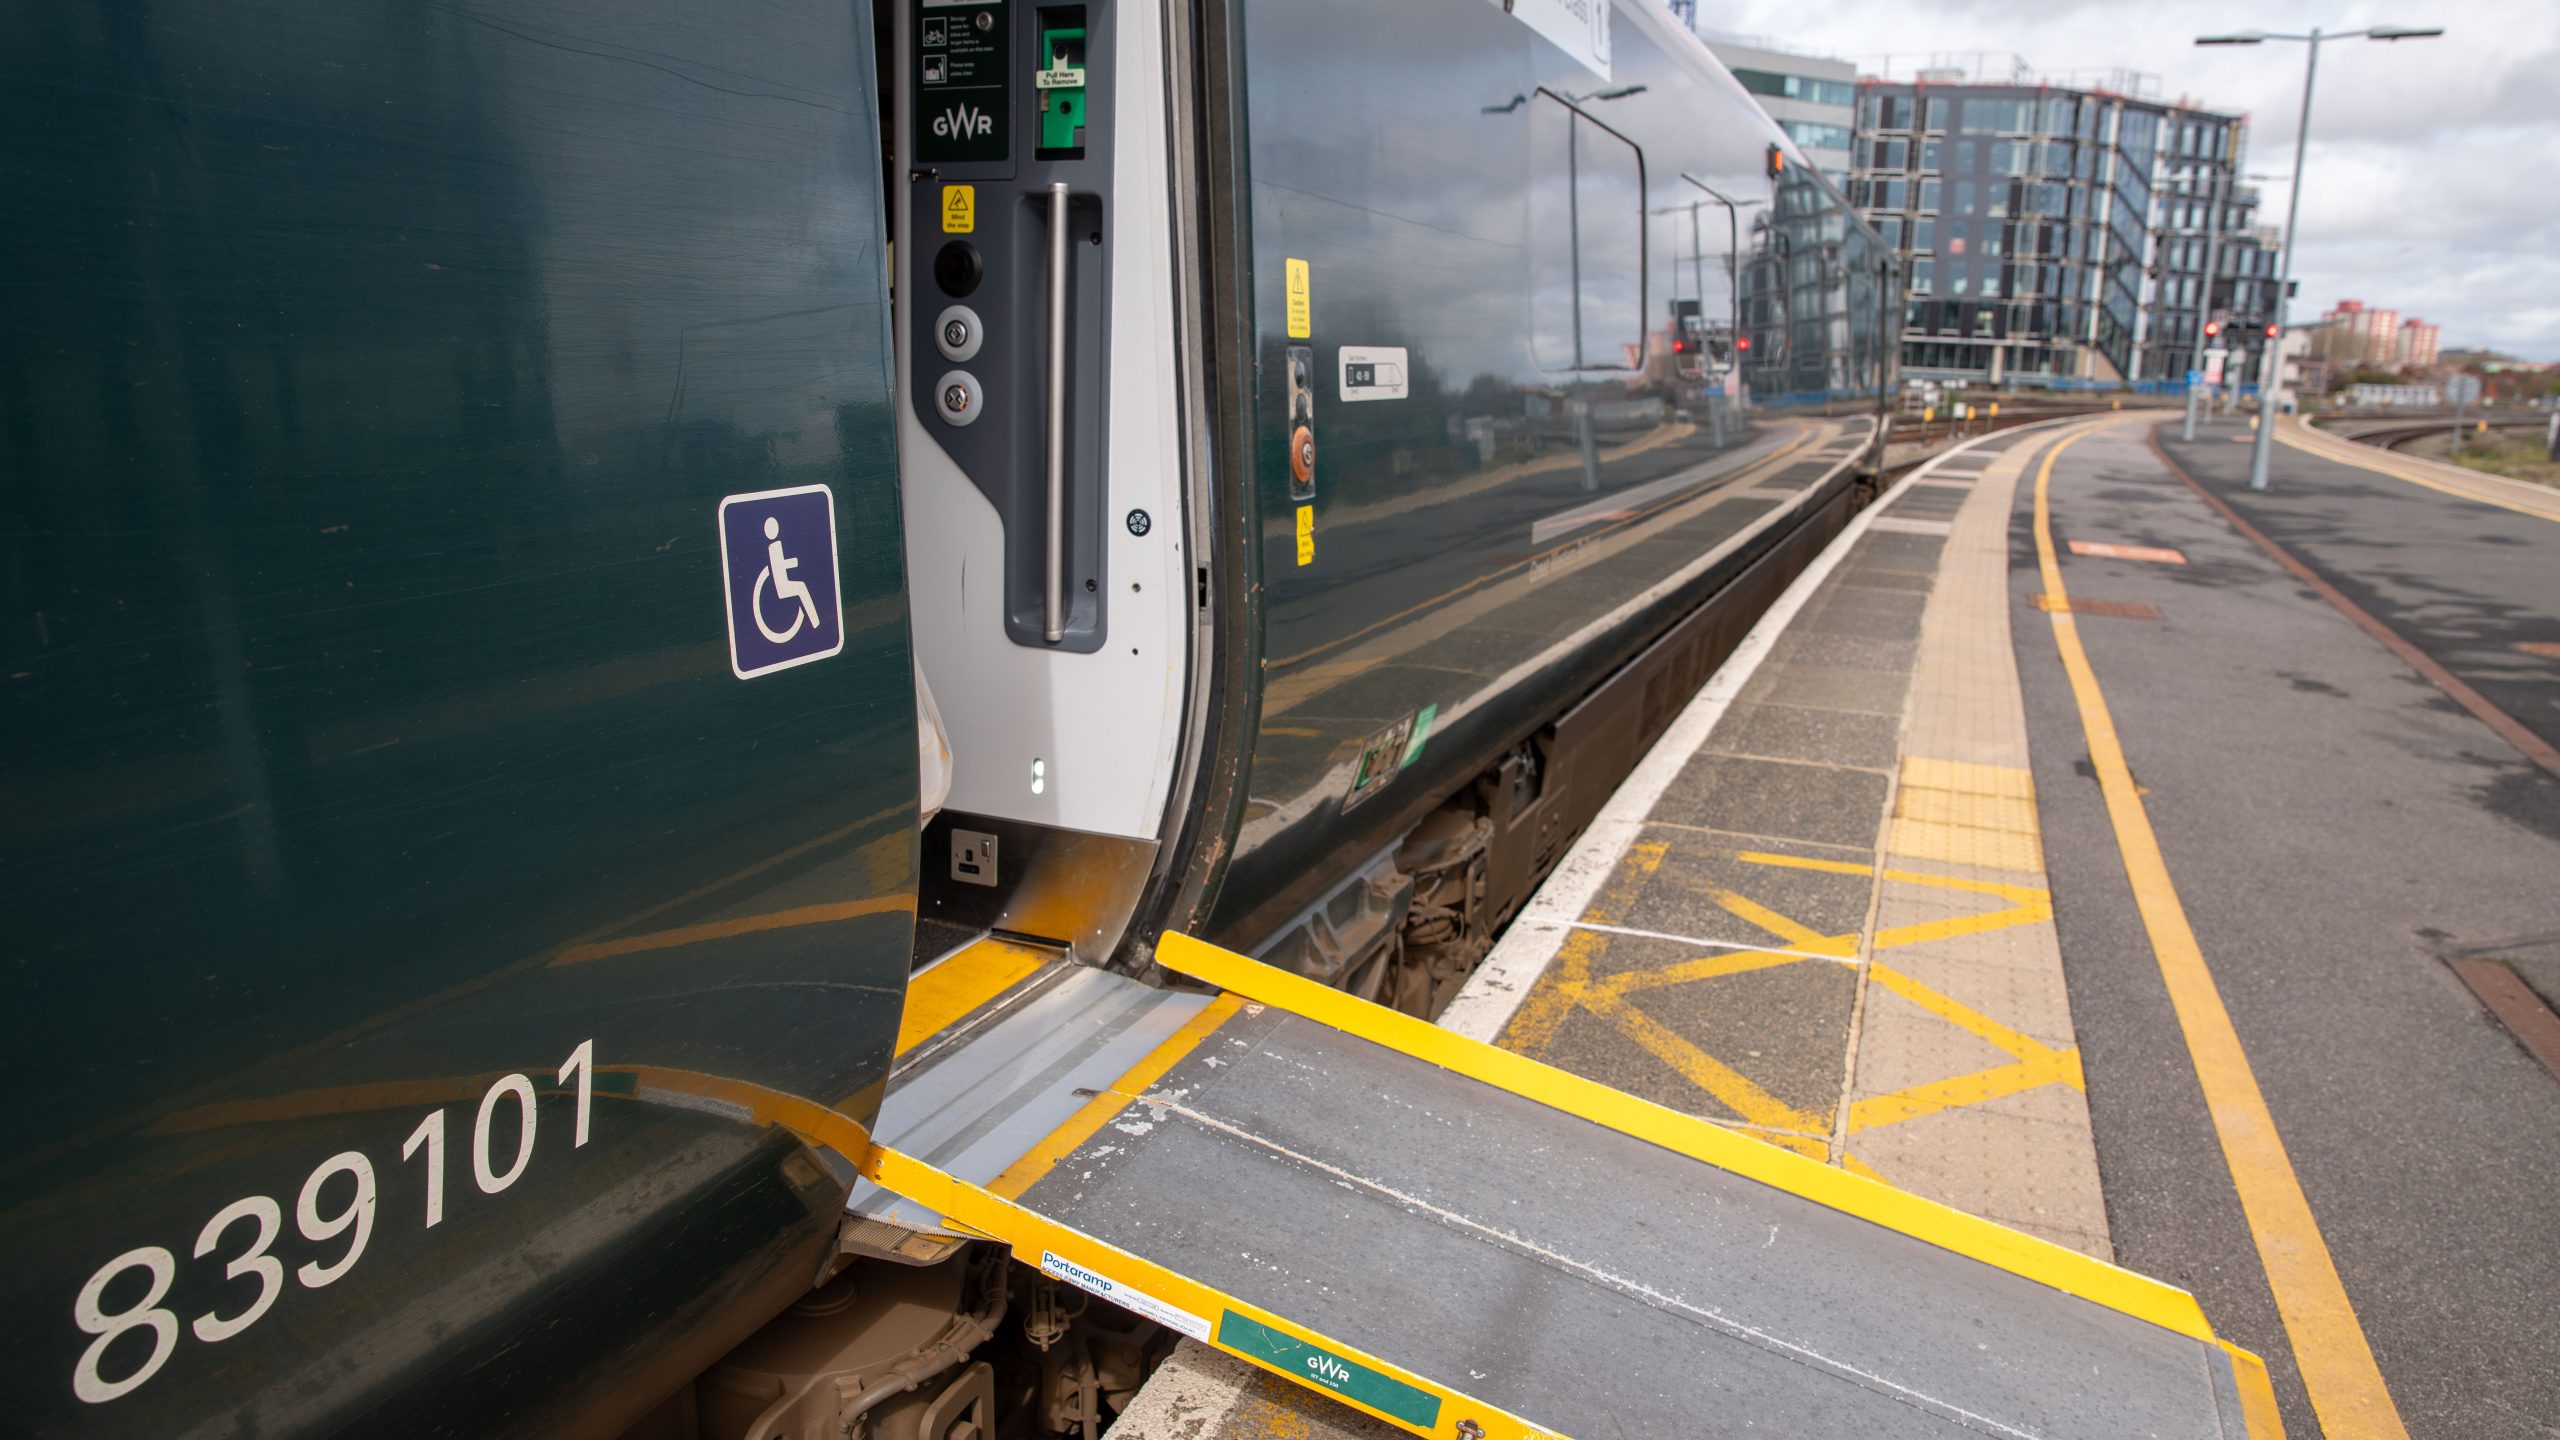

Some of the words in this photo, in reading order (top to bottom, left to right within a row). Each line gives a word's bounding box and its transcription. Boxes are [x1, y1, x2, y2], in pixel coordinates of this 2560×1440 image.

[1052, 78, 1078, 86] Remove
[933, 102, 992, 141] GWR
[73, 1038, 593, 1405] 839101
[1044, 1252, 1112, 1291] Portaramp
[1081, 1283, 1130, 1308] MANUFACTURERS
[1307, 1355, 1350, 1383] GWR
[1319, 1376, 1329, 1384] and
